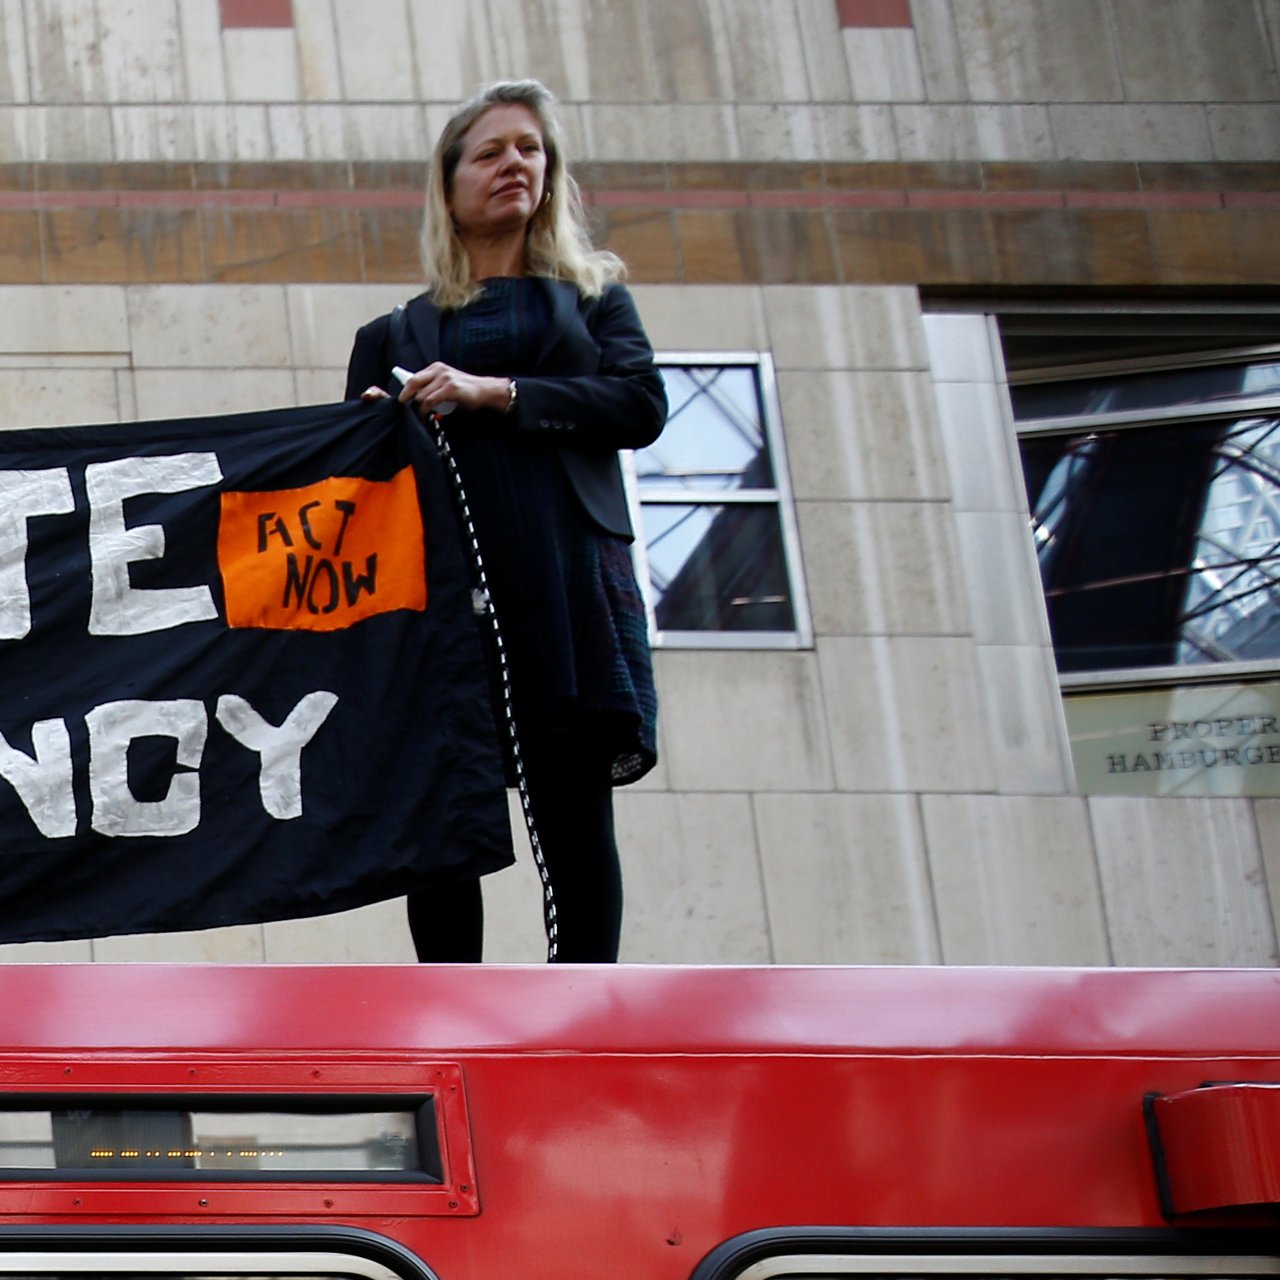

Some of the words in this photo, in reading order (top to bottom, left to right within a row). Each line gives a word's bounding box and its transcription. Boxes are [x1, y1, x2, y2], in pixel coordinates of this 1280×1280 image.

[254, 499, 357, 559] ACT
[280, 551, 378, 614] NOW
[1145, 715, 1280, 742] PROPER
